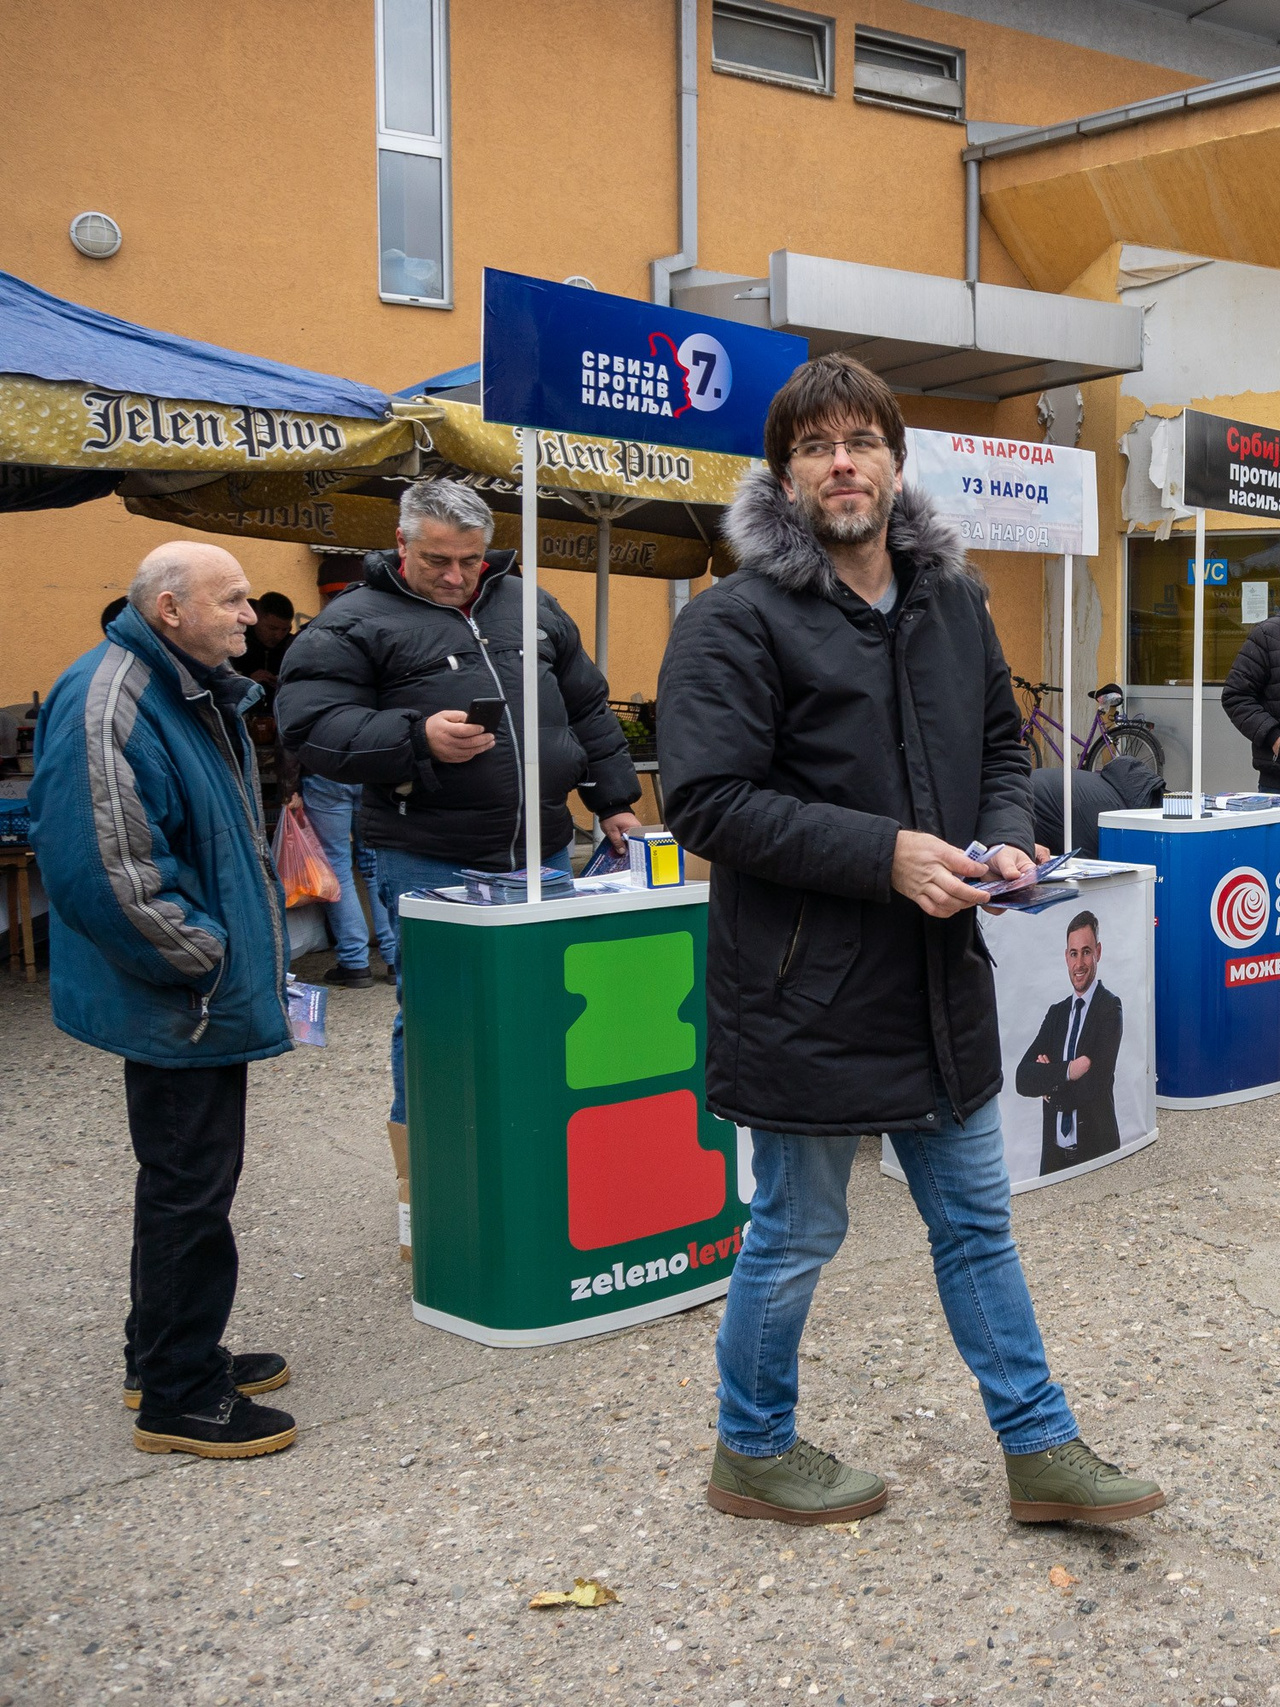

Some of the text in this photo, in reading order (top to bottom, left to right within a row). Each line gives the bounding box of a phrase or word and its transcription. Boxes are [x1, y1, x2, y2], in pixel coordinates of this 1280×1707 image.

[581, 350, 670, 382] СРБИЈА
[691, 349, 722, 399] 7.
[581, 368, 669, 399] ПРОТИВ
[581, 387, 674, 418] НАСИЉА
[82, 391, 346, 461] Jelen Pivo
[613, 438, 693, 486] Pivo
[951, 436, 1055, 465] ИЗ НАРОДА
[961, 476, 1049, 504] УЗ НАРОД
[960, 519, 1050, 547] ЗА НАРОД
[570, 1220, 751, 1302] zelenolevif
